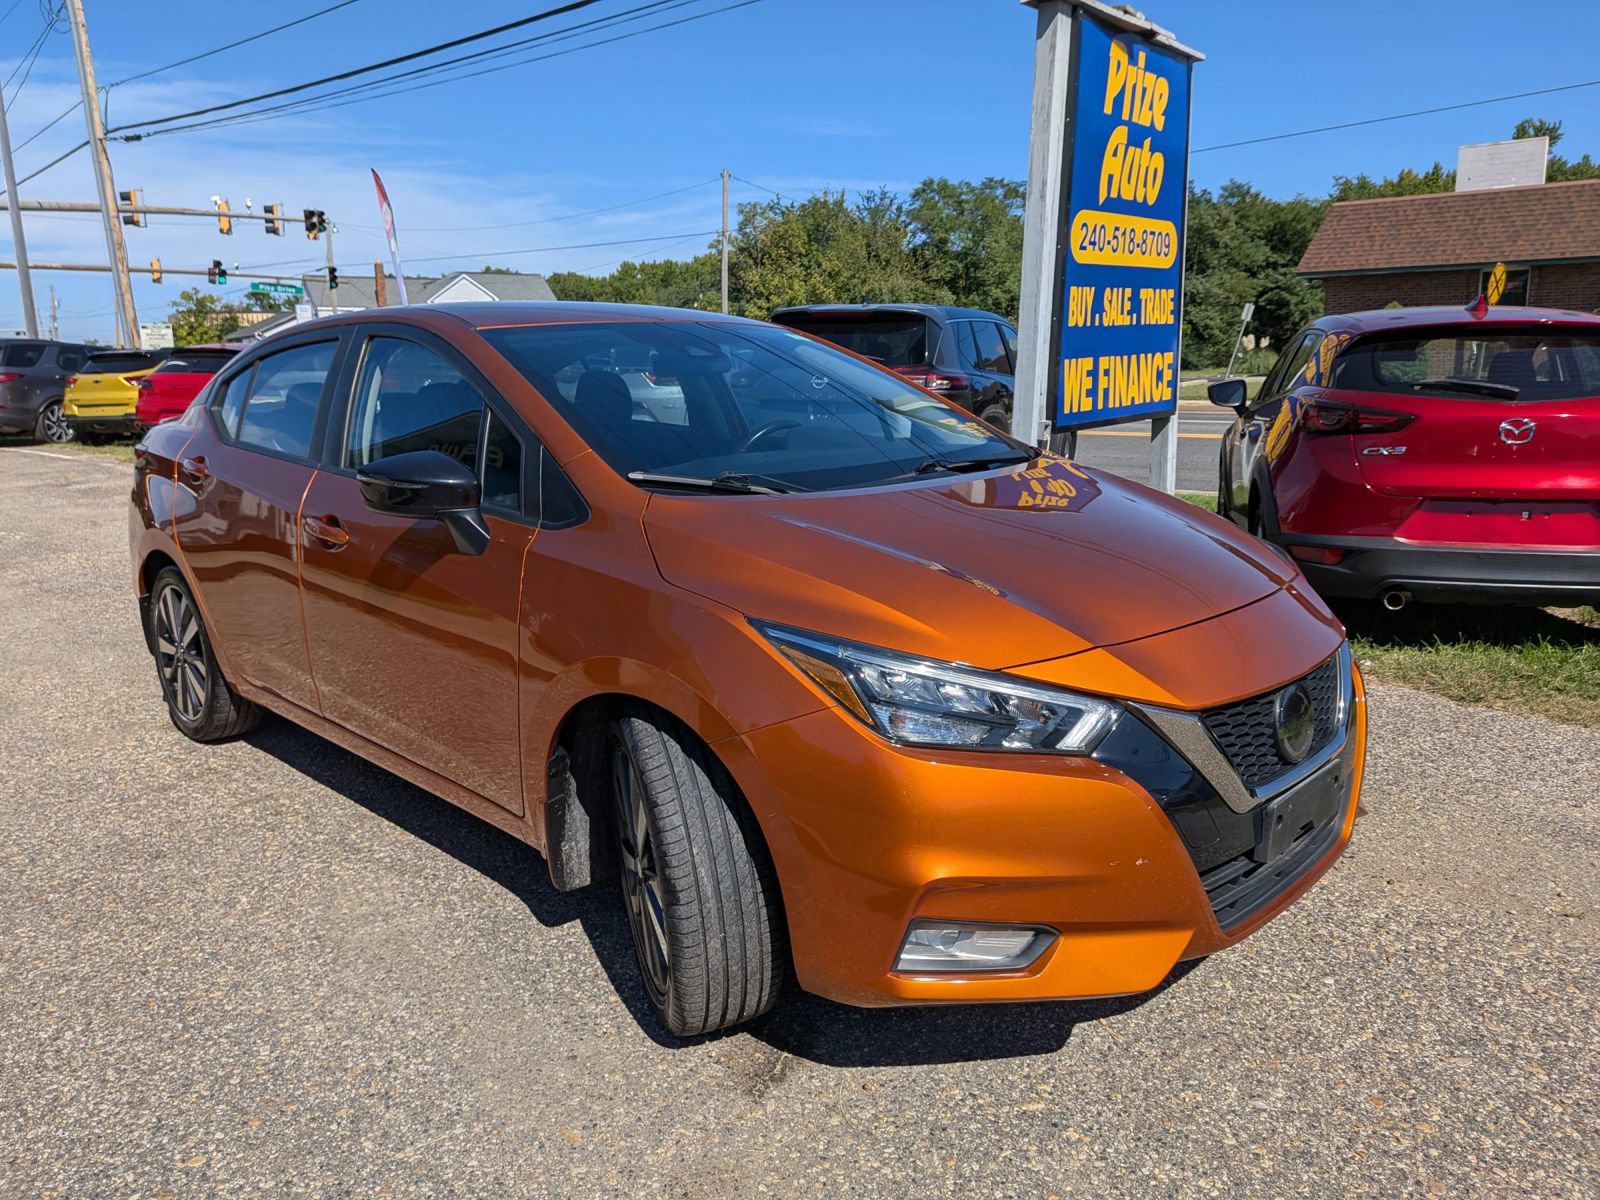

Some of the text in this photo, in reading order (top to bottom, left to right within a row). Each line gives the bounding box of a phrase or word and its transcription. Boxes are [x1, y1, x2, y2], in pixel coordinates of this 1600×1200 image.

[1103, 39, 1169, 132] Prize
[1099, 125, 1164, 206] Auto
[1079, 222, 1170, 257] 240-518-8709
[1139, 288, 1175, 325] TRADE
[1063, 351, 1174, 414] WE FINANCE
[1362, 446, 1407, 455] CX-3
